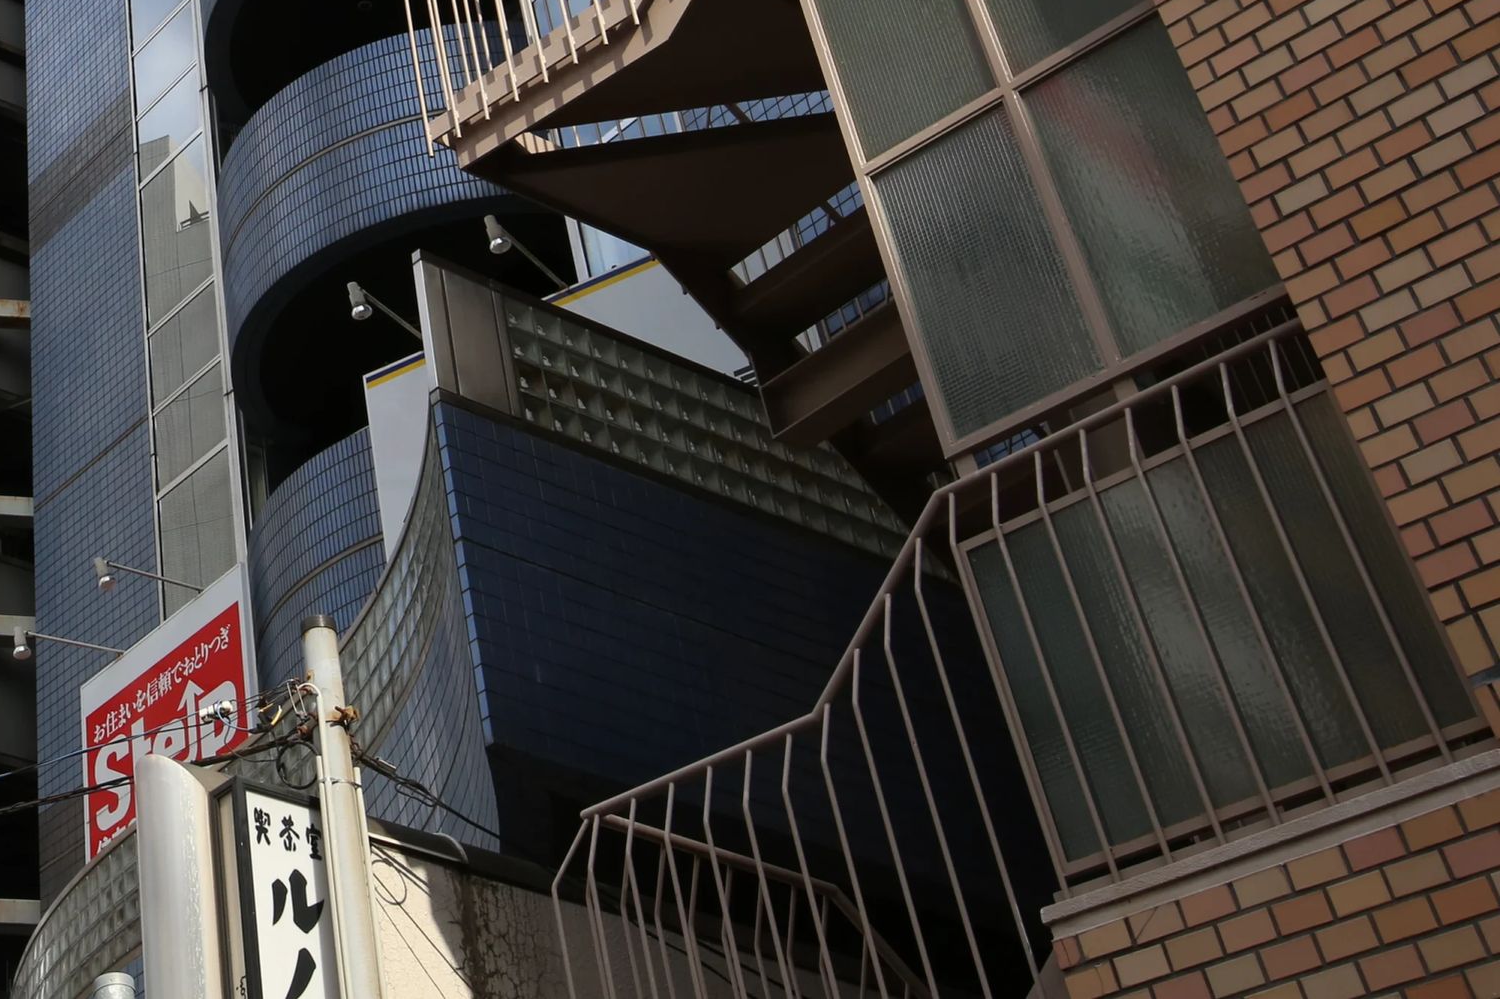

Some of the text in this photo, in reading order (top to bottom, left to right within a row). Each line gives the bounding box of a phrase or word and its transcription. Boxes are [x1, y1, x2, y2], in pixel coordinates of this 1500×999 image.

[93, 623, 231, 743] お住まいを信頼でおとりつぎ
[253, 807, 323, 861] 喫茶室
